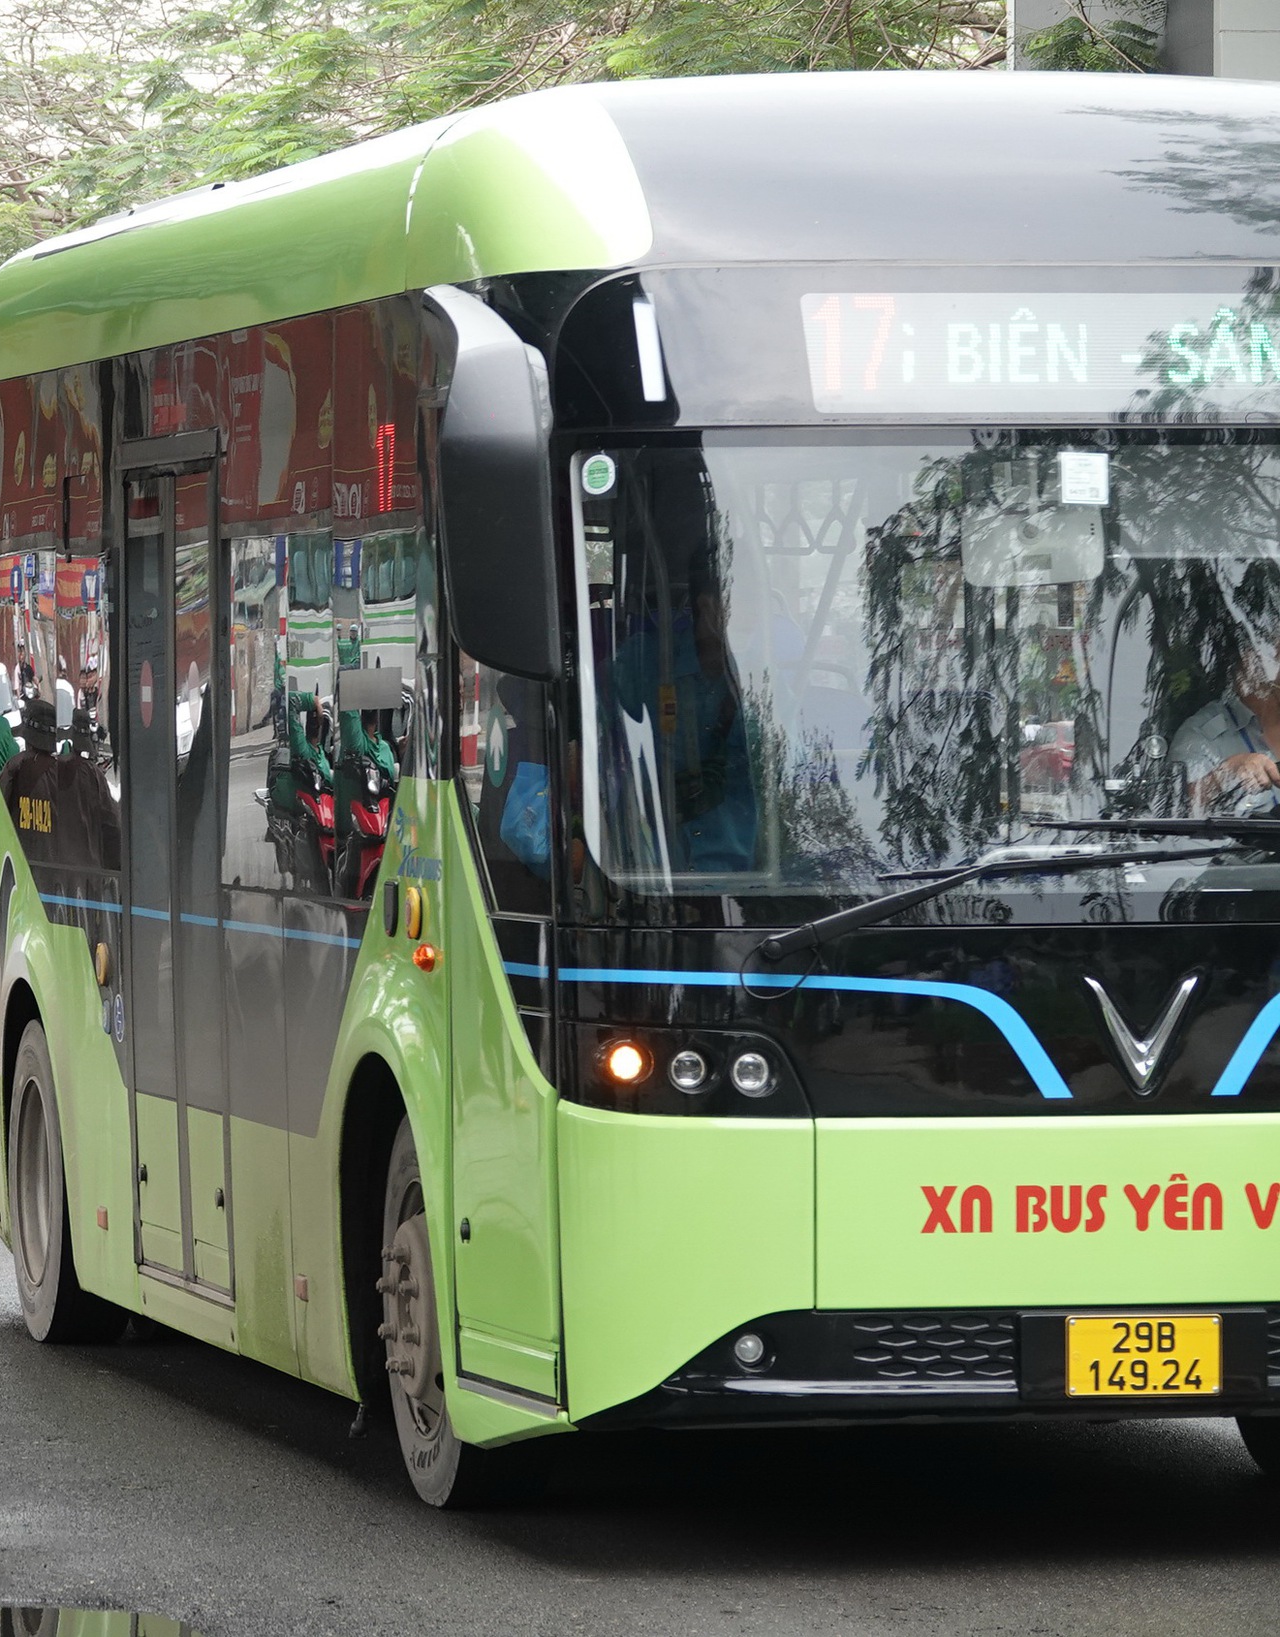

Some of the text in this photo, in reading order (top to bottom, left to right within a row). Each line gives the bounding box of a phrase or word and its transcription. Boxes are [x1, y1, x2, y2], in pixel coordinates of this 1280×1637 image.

[812, 296, 895, 391] 17
[946, 307, 1088, 383] BIÊN
[1016, 1184, 1108, 1234] BUS
[1123, 1173, 1223, 1232] YÊN
[1113, 1322, 1175, 1354] 29B
[1089, 1359, 1202, 1392] 149.24
